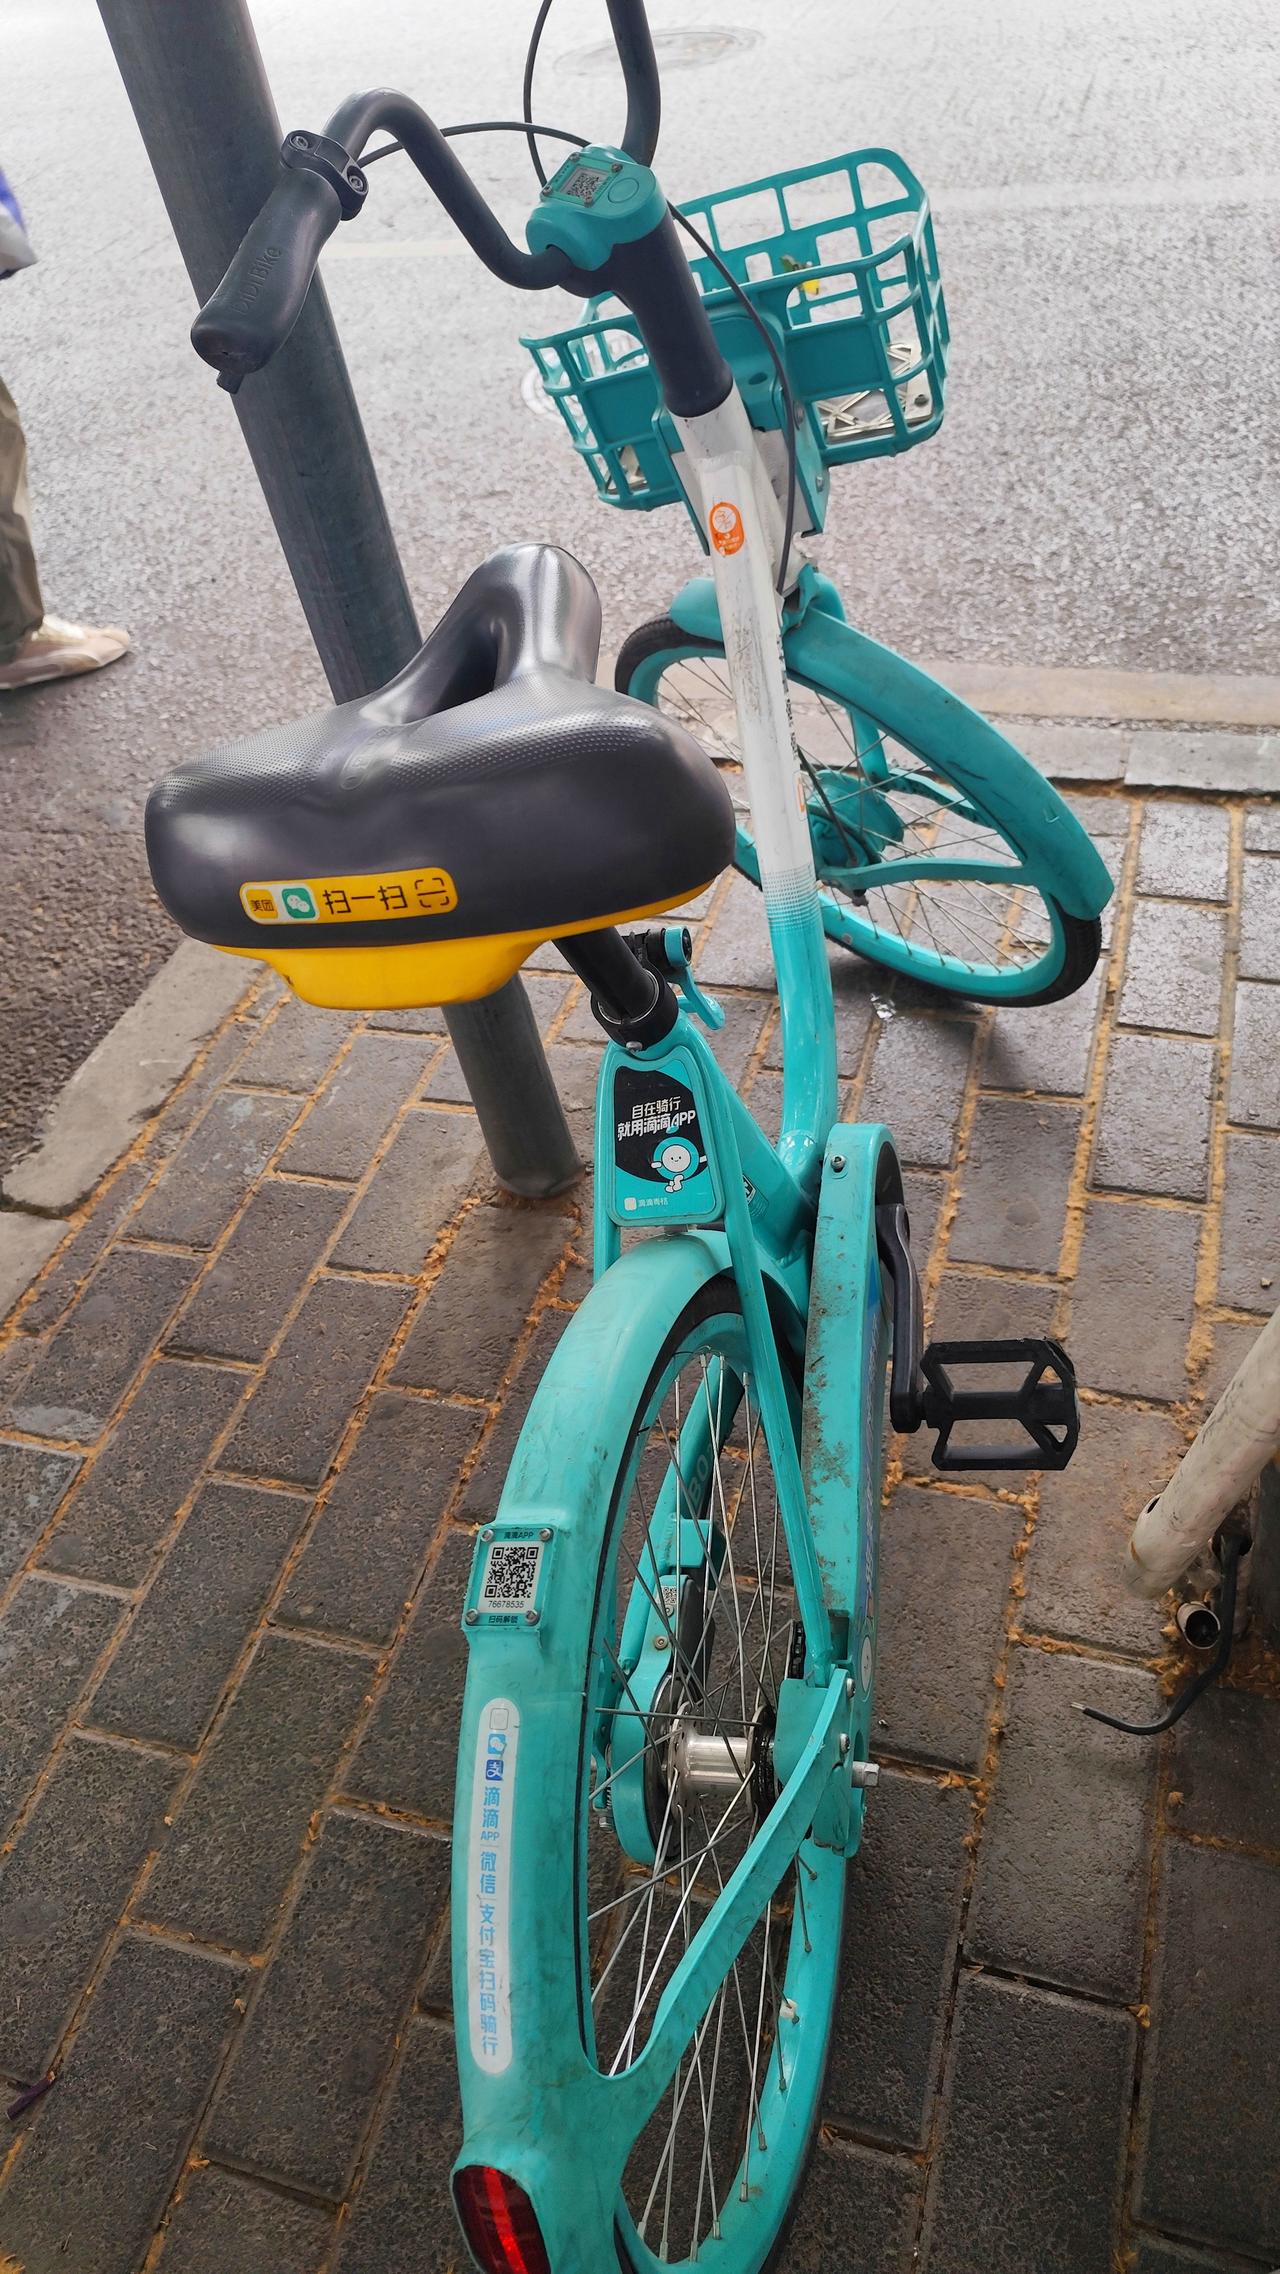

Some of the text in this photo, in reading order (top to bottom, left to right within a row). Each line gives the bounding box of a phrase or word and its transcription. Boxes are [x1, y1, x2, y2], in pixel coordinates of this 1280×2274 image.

[322, 885, 409, 915] 扫一扫
[631, 1096, 682, 1120] 自在骑行
[617, 1110, 697, 1142] 就用滴滴APP
[488, 1600, 525, 1609] 76678535
